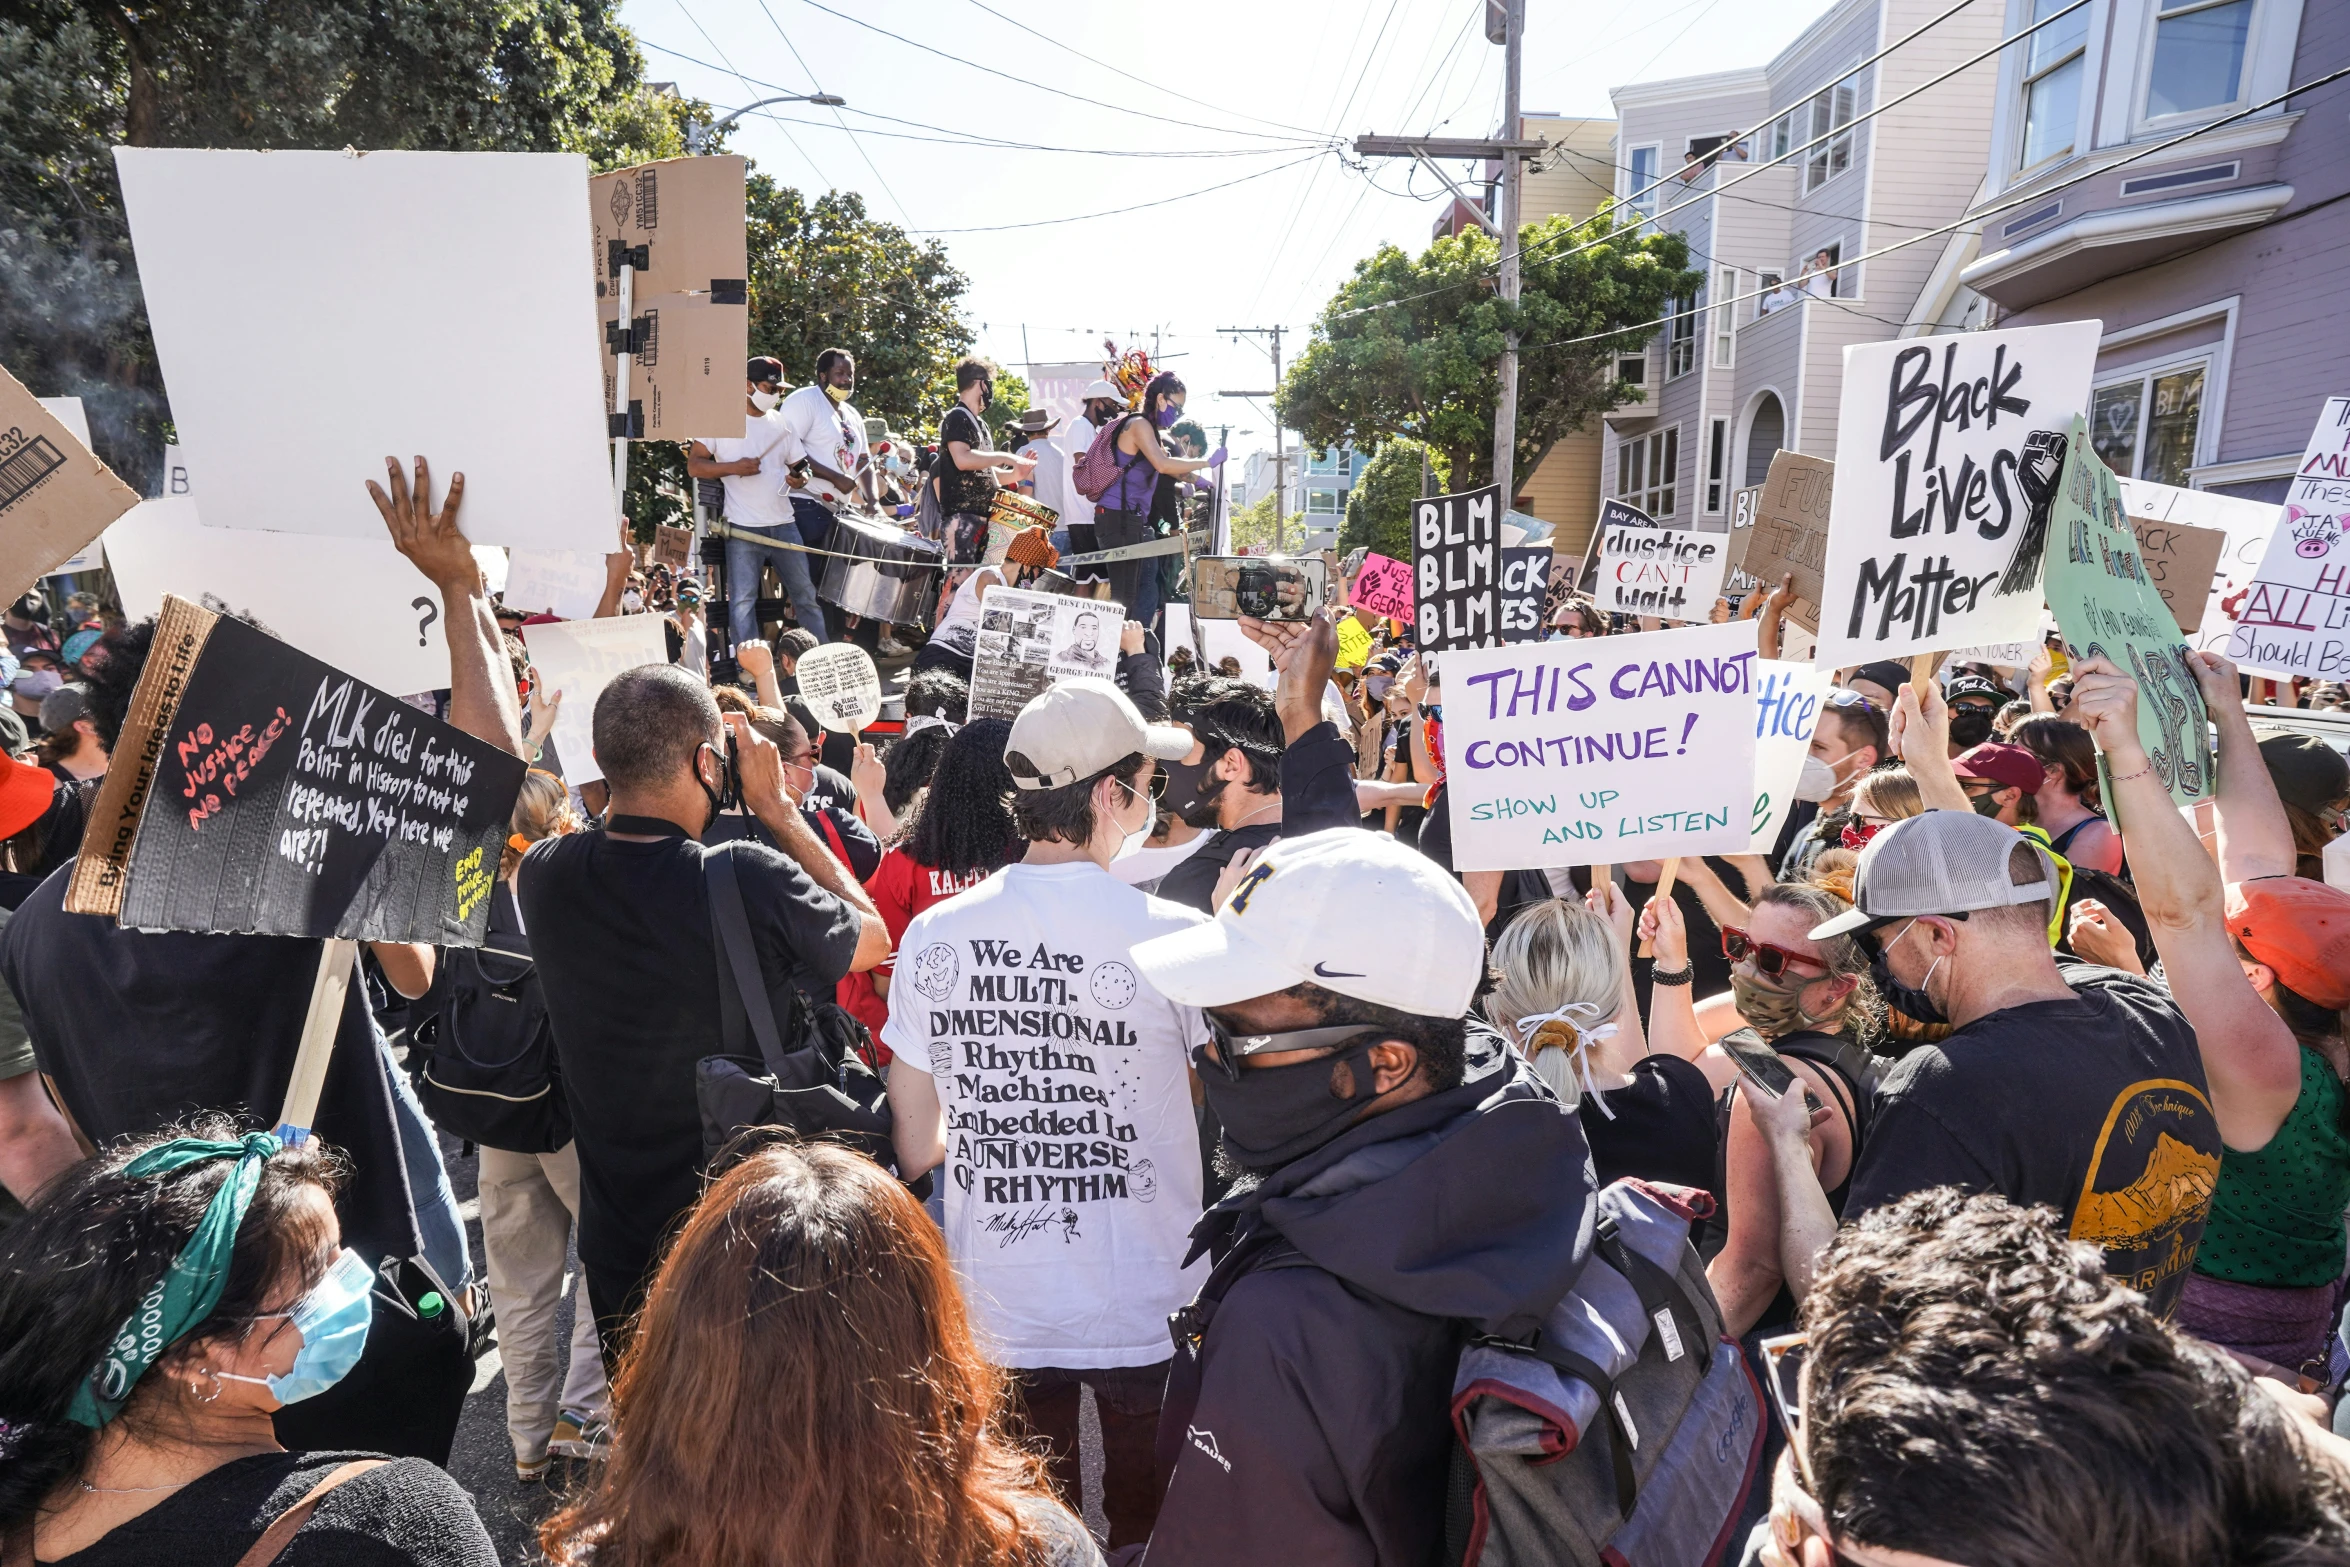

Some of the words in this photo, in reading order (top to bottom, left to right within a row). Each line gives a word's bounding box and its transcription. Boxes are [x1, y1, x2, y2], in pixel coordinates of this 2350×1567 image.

[635, 177, 644, 229] YM51CC32
[1880, 342, 2031, 472] Black
[0, 426, 29, 463] C32
[2302, 452, 2350, 477] MU
[1780, 467, 1833, 513] FUC
[1889, 448, 2018, 541] Lives
[1418, 493, 1493, 550] BLM
[1610, 509, 1629, 522] BAY
[1734, 490, 1757, 529] BL
[2292, 528, 2341, 547] KUENG
[1392, 582, 1406, 598] 4
[1418, 543, 1493, 600] BLM
[1616, 561, 1698, 584] CAN'T
[1057, 598, 1080, 608] REST
[1082, 602, 1091, 610] IN
[1094, 604, 1124, 616] POWER
[1370, 593, 1414, 620] GEORG
[1846, 553, 1999, 641] Matter
[2243, 584, 2315, 627] ALL
[2324, 599, 2350, 629] Li
[411, 597, 438, 647] ?
[1419, 590, 1493, 646] BLM
[1339, 630, 1372, 656] ATTER
[2228, 626, 2312, 668] Should
[974, 685, 986, 693] You
[1050, 665, 1083, 677] GEORGE
[1467, 662, 1597, 719] THIS
[1610, 650, 1758, 700] CANNOT
[844, 709, 864, 718] MATTER
[972, 704, 985, 712] And
[1012, 700, 1028, 708] targe
[1757, 671, 1816, 741] tice
[301, 675, 376, 749] MLK
[374, 711, 416, 764] died
[420, 736, 445, 777] for
[445, 748, 475, 786] this
[1464, 713, 1699, 770] CONTINUE!
[100, 827, 133, 887] Bring
[120, 764, 149, 821] Your
[147, 702, 172, 759] Ideas
[164, 674, 180, 701] to
[297, 737, 343, 781] Point
[348, 753, 363, 784] in
[366, 761, 413, 806] History
[413, 775, 429, 806] to
[428, 787, 452, 815] not
[452, 793, 469, 818] be
[1470, 794, 1557, 821] SHOW
[1580, 789, 1620, 809] UP
[365, 797, 397, 840] Yet
[400, 809, 430, 845] here
[433, 826, 454, 853] we
[1542, 820, 1603, 845] AND
[1618, 806, 1728, 838] LISTEN
[969, 939, 1021, 968] We
[1027, 942, 1084, 974] Are
[969, 975, 1078, 1006] MULTI-
[929, 1009, 1138, 1047] DMENSIONAL
[961, 1041, 1097, 1077] Rhythm
[954, 1073, 1109, 1108] Machines
[948, 1104, 1100, 1136] Embedded
[1104, 1112, 1138, 1142] In
[2124, 1107, 2144, 1145] 100%
[2139, 1093, 2196, 1120] Technique
[954, 1133, 972, 1162] A
[973, 1138, 1130, 1170] UNIVERSE
[954, 1163, 975, 1195] OF
[984, 1173, 1128, 1204] RHYTHM
[1716, 1394, 1748, 1464] Google
[1194, 1438, 1232, 1473] BAUER
